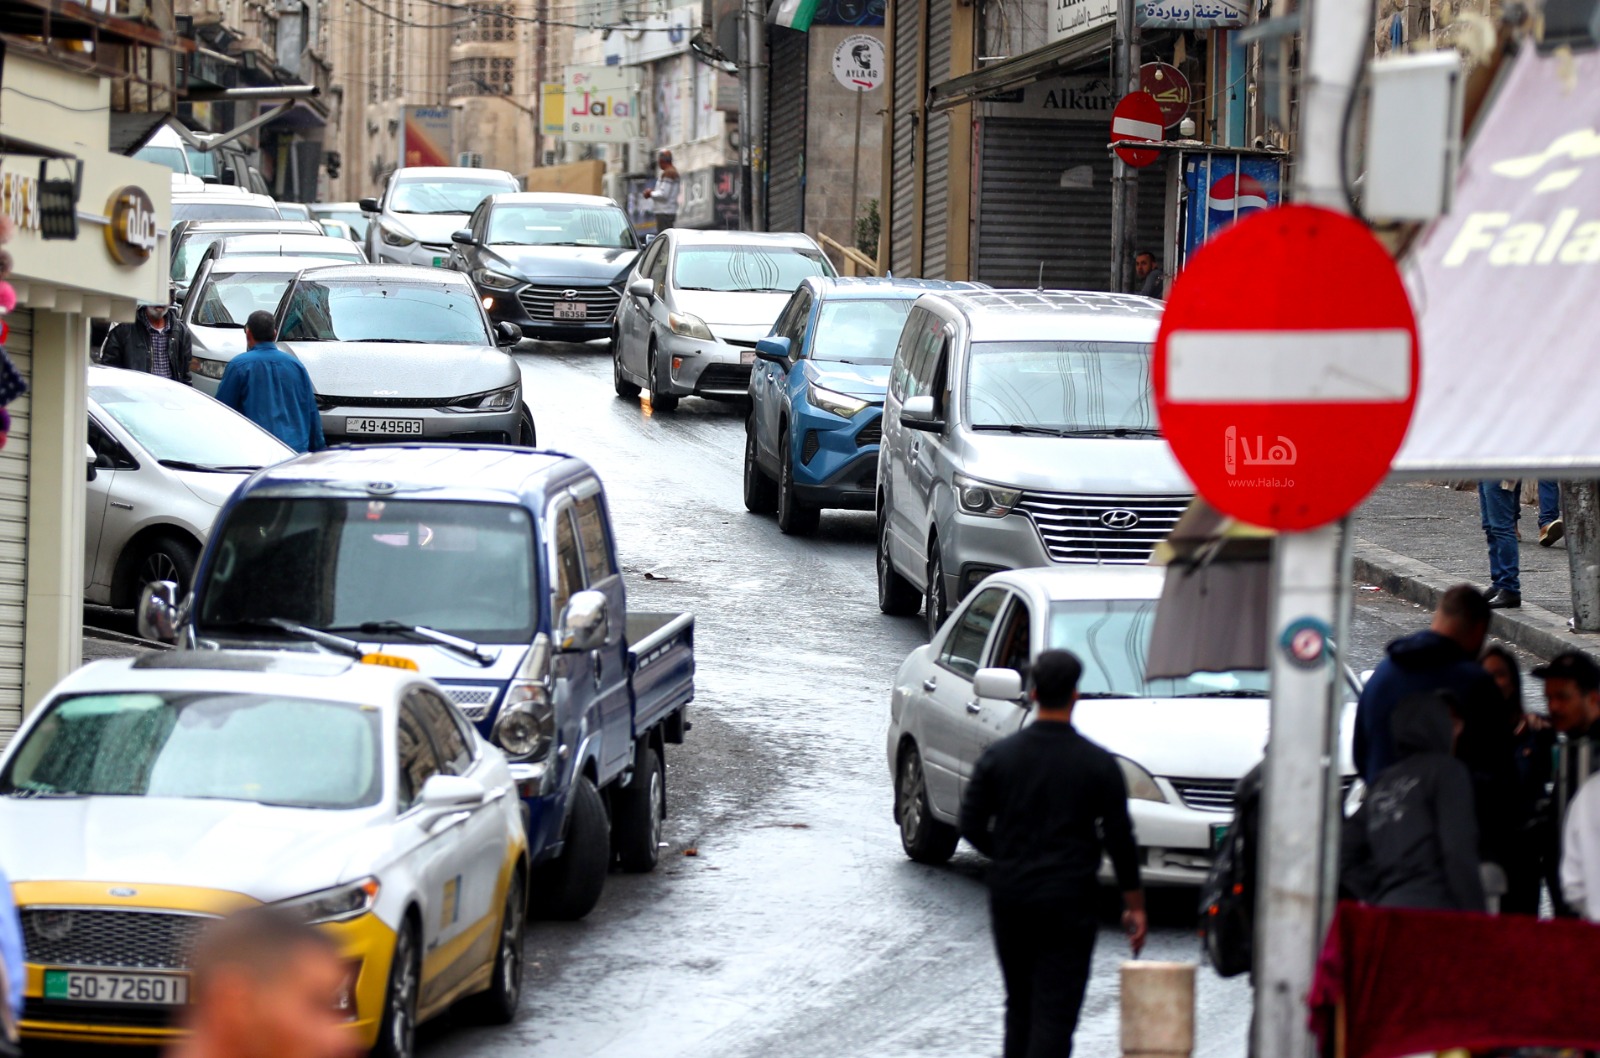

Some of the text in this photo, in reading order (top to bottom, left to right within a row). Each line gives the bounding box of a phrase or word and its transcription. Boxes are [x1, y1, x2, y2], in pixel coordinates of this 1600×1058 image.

[1147, 3, 1239, 21] ساخنة وباردة
[845, 69, 866, 78] AYLA
[572, 91, 637, 117] Jalal
[360, 419, 421, 433] 49-49583
[68, 975, 178, 1002] 50-72601
